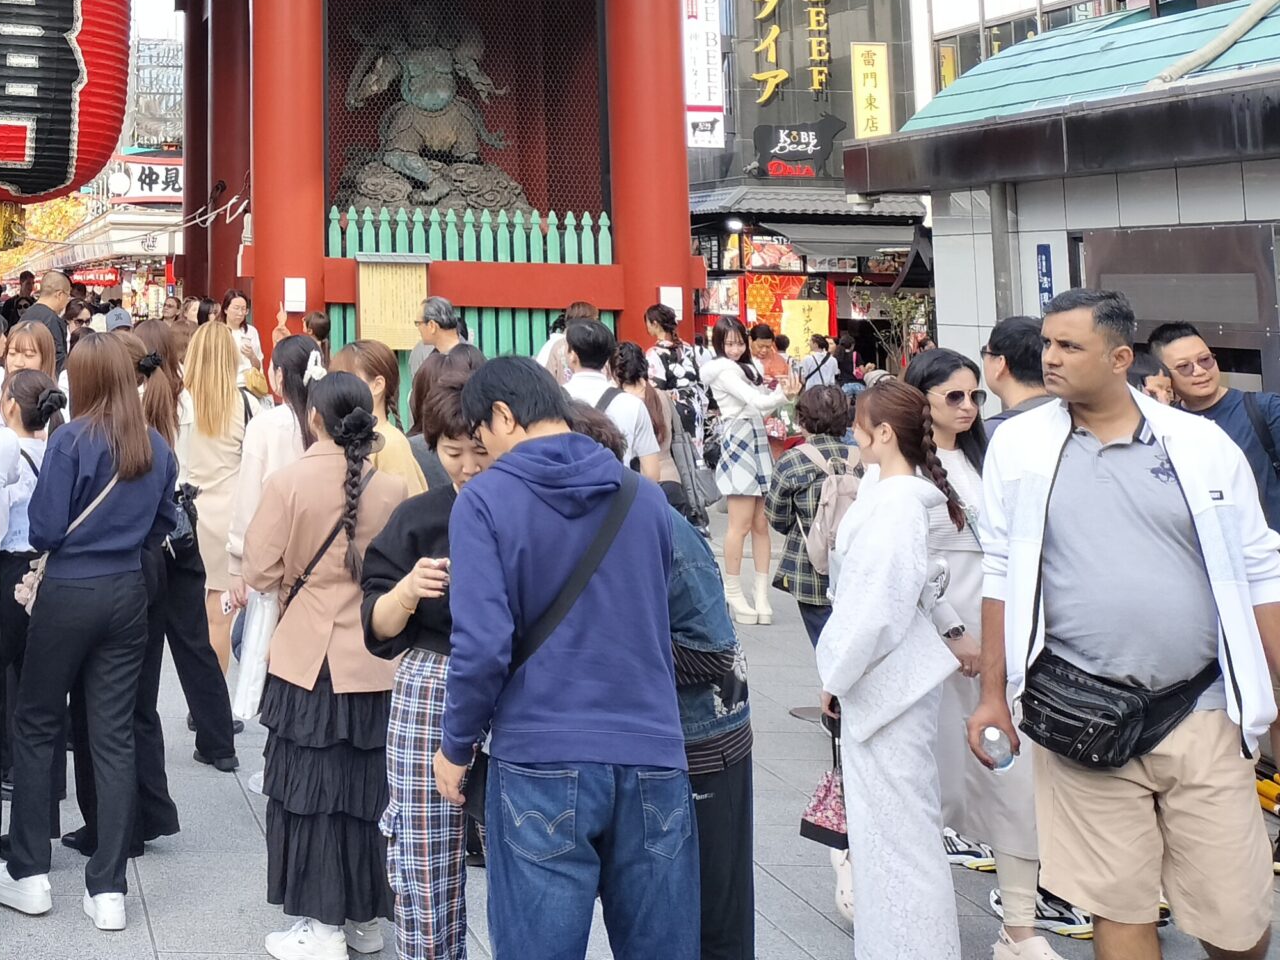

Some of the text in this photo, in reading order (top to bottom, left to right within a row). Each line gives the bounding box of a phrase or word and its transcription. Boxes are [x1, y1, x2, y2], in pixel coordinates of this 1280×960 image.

[705, 31, 718, 101] BEEF
[860, 50, 880, 132] 雷門東店
